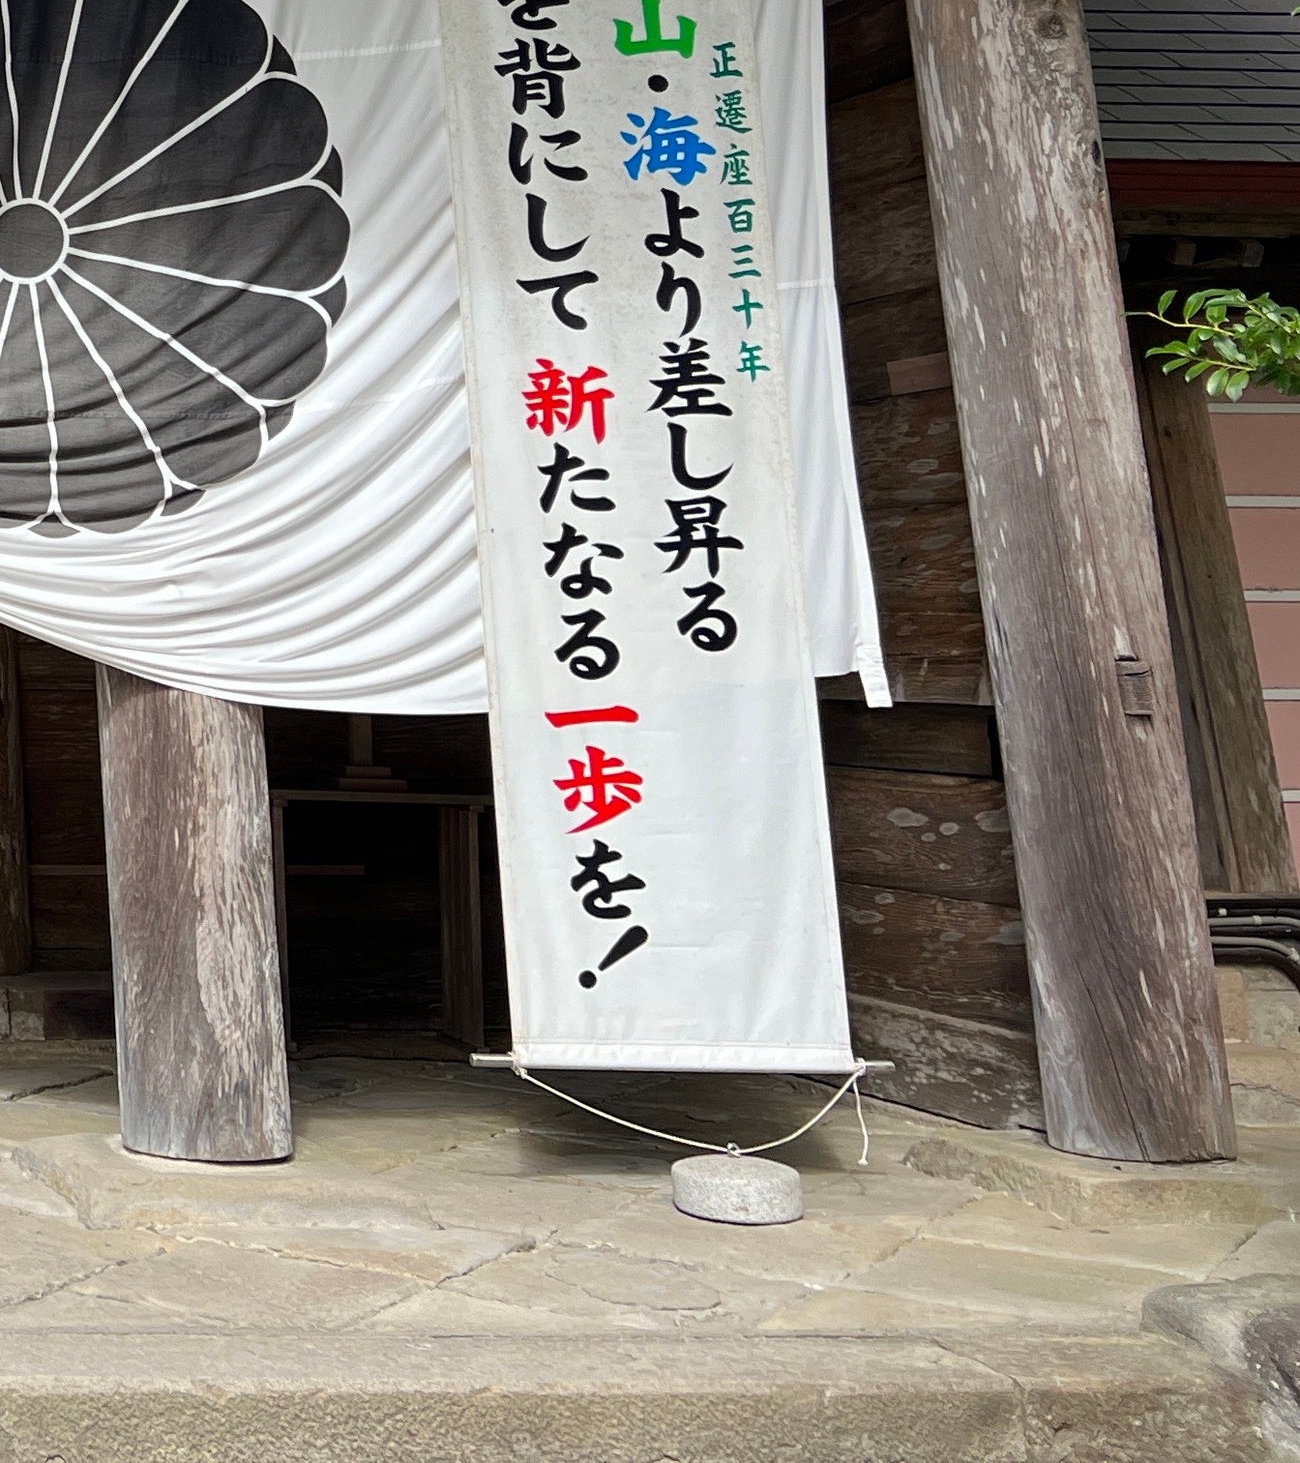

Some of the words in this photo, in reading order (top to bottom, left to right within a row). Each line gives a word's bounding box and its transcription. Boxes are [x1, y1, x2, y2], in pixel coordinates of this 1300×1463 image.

[709, 41, 771, 382] 正遷座百三十年
